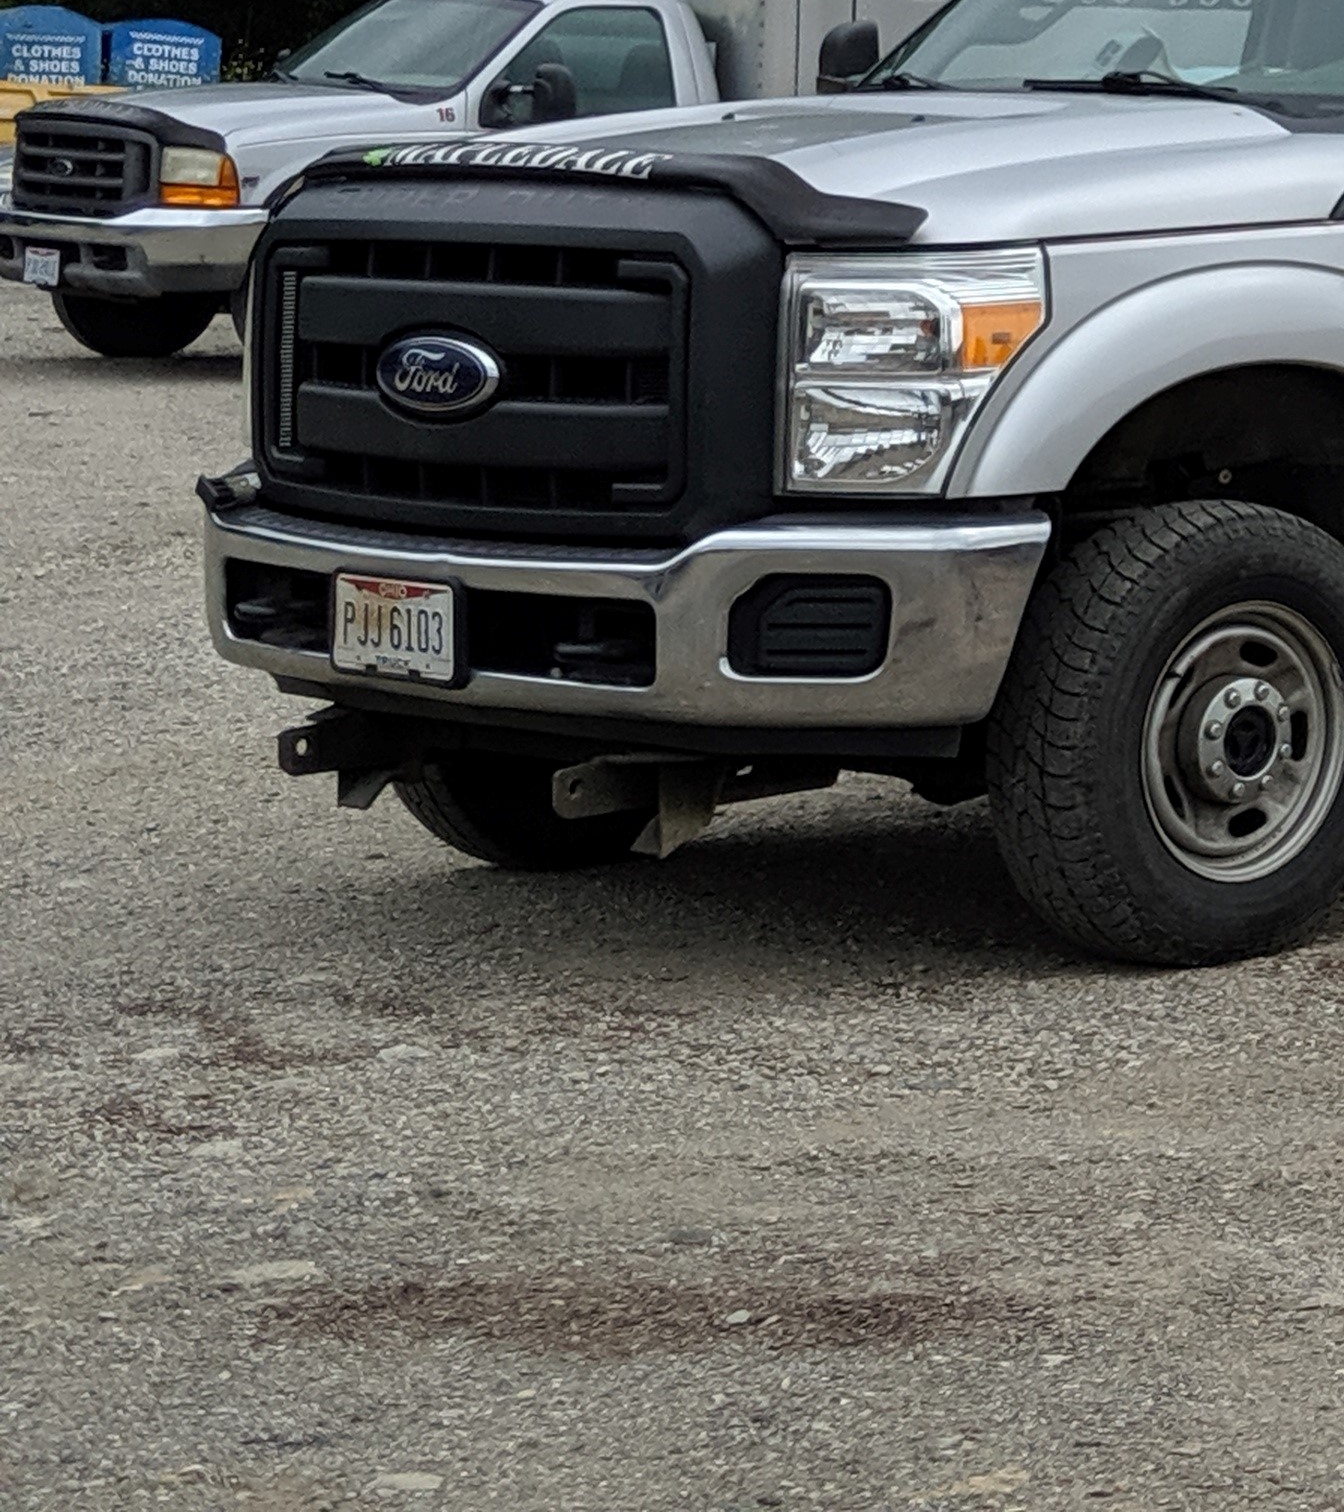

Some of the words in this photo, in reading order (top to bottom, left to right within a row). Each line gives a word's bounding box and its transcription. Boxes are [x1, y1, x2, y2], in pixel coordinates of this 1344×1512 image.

[11, 44, 82, 58] CLOTHES
[133, 43, 199, 61] CLOTHES
[29, 60, 80, 73] SHOES
[148, 59, 198, 74] SHOES
[8, 73, 86, 87] DONATION
[127, 71, 202, 88] DONATION
[394, 349, 460, 394] Ford
